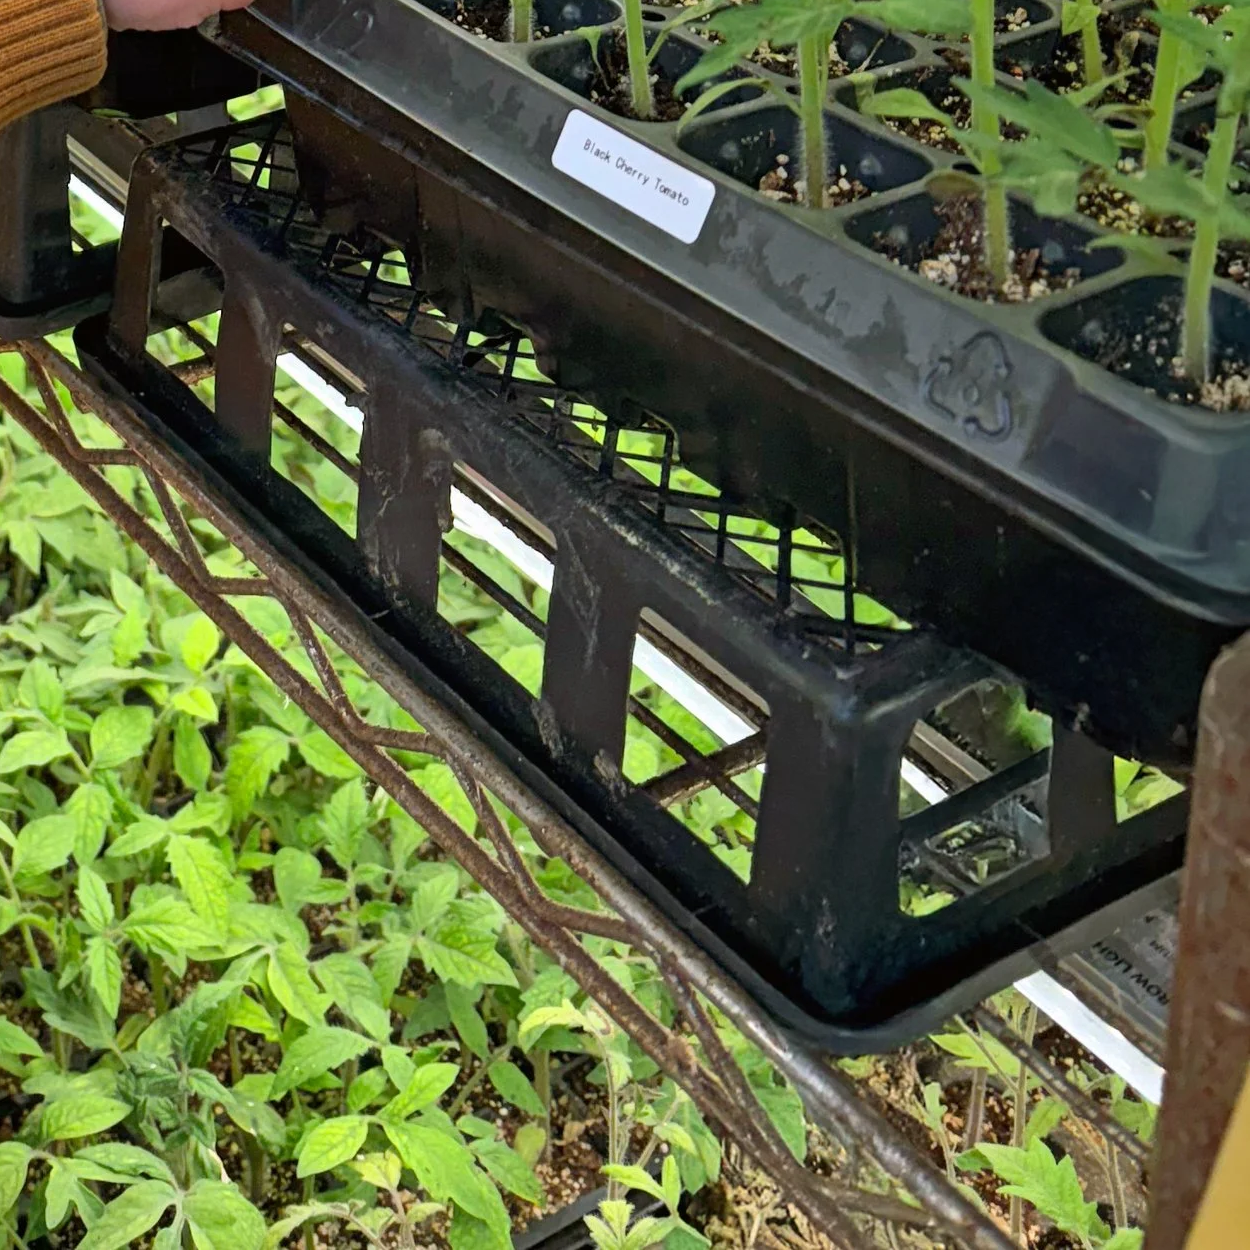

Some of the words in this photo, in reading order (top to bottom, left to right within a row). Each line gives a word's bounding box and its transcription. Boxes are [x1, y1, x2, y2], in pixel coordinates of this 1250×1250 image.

[582, 138, 611, 164] Black
[615, 157, 650, 186] Cherry
[655, 178, 690, 206] Tomato
[1092, 941, 1133, 974] LIGH
[1130, 973, 1170, 1006] ROW
